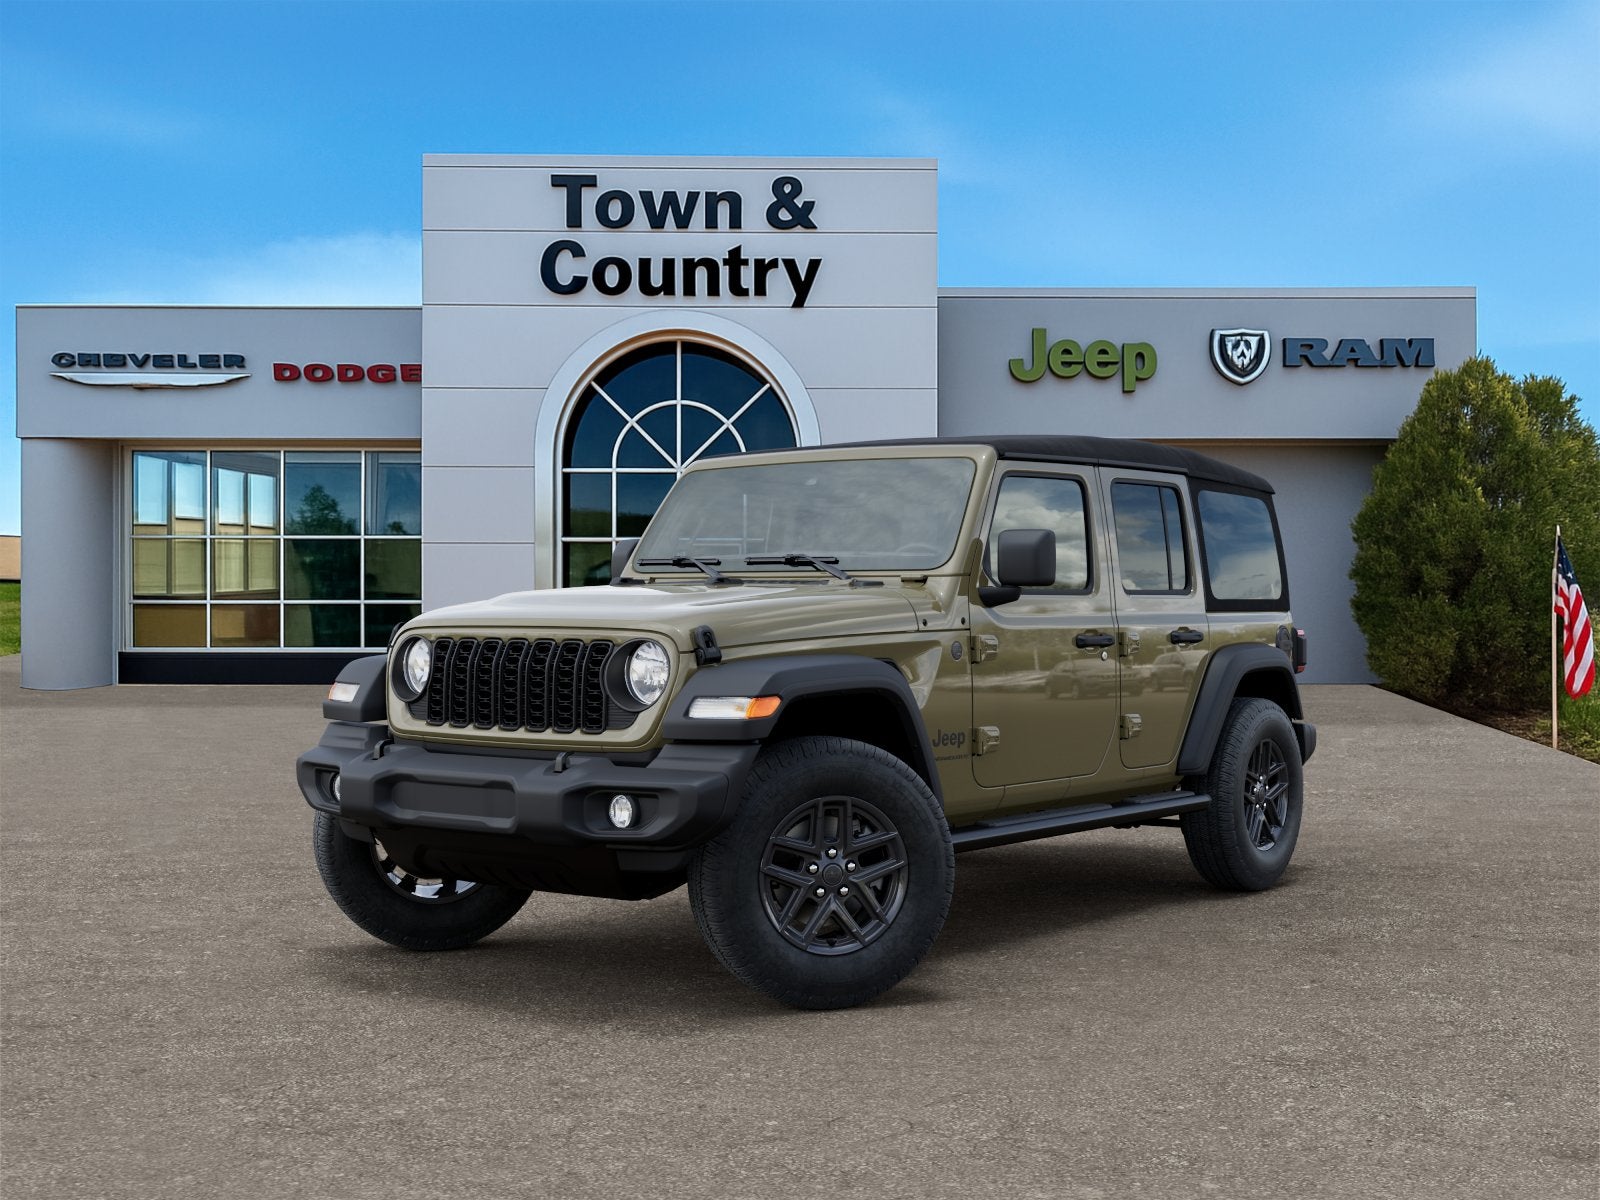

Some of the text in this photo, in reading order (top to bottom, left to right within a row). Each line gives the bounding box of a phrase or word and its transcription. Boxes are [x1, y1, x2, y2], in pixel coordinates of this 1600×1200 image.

[551, 174, 818, 230] Town &
[540, 239, 822, 308] Country
[273, 362, 422, 383] DODGE
[1009, 328, 1157, 393] Jeep
[1283, 338, 1435, 367] RAM
[932, 728, 966, 748] Jeep
